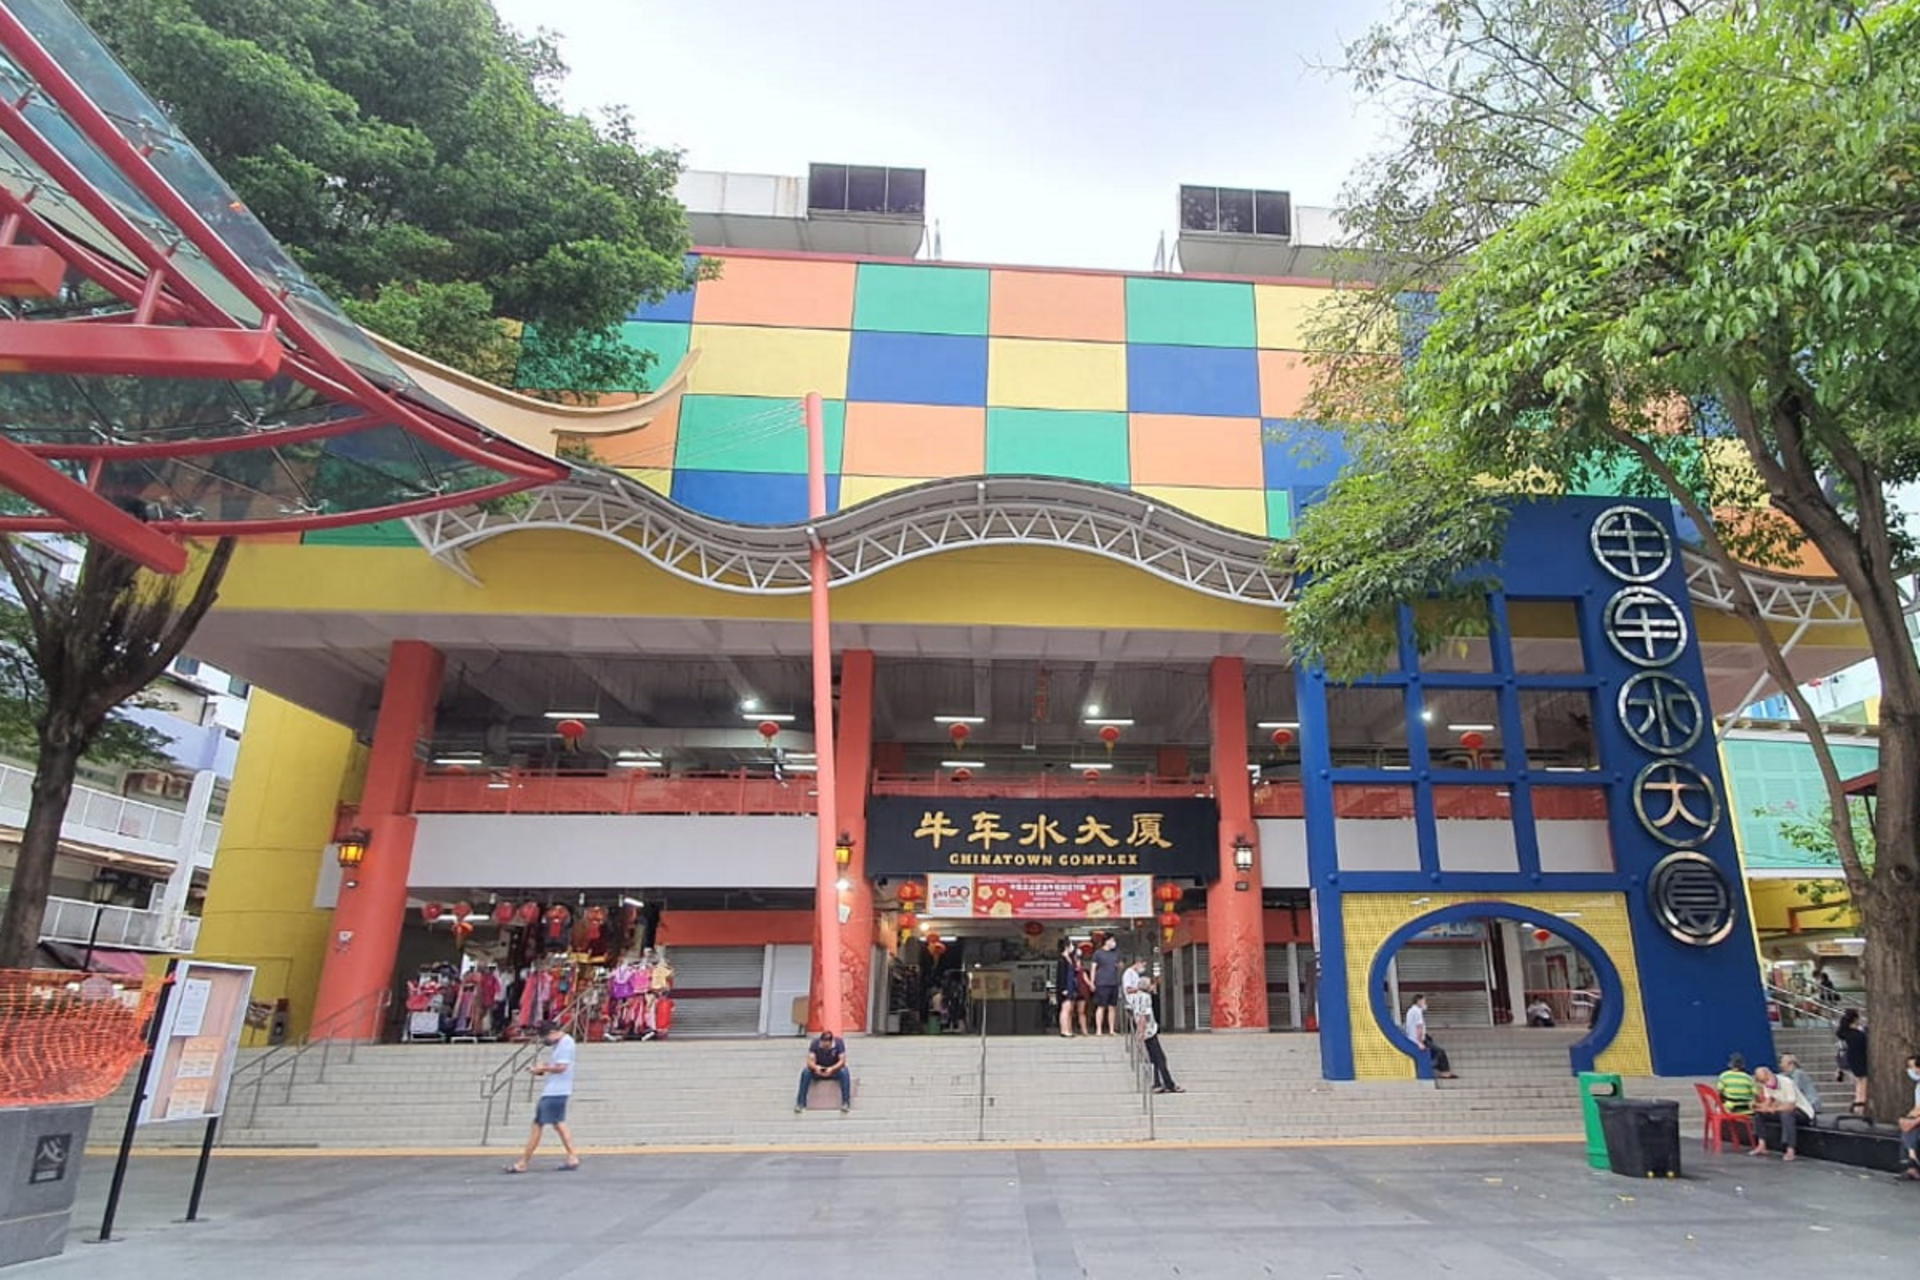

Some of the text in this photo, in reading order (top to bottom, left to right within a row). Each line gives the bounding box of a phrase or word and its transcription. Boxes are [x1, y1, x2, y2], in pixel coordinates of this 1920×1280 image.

[913, 810, 1173, 850] 牛车水大厦
[949, 853, 1139, 866] CHINATOWN COMPLEX
